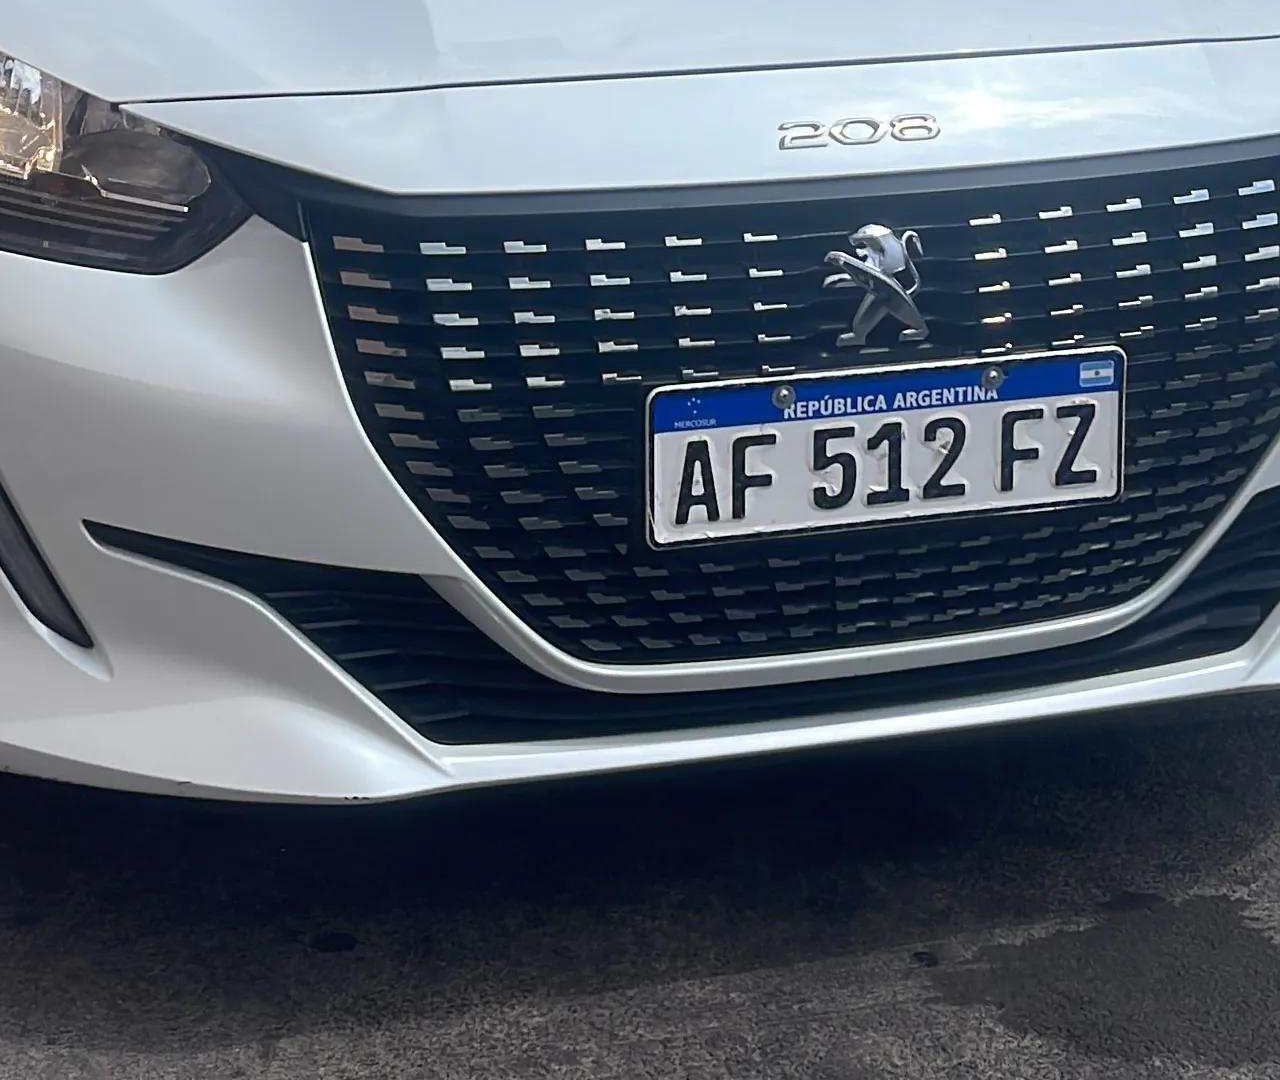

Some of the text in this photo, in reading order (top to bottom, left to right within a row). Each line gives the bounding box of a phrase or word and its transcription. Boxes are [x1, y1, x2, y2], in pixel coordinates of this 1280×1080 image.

[778, 113, 941, 150] 208
[783, 385, 998, 419] REPÚBLICA ARGENTINA
[673, 418, 717, 429] MERCOSUR
[674, 404, 1098, 525] AF 512 FZ
